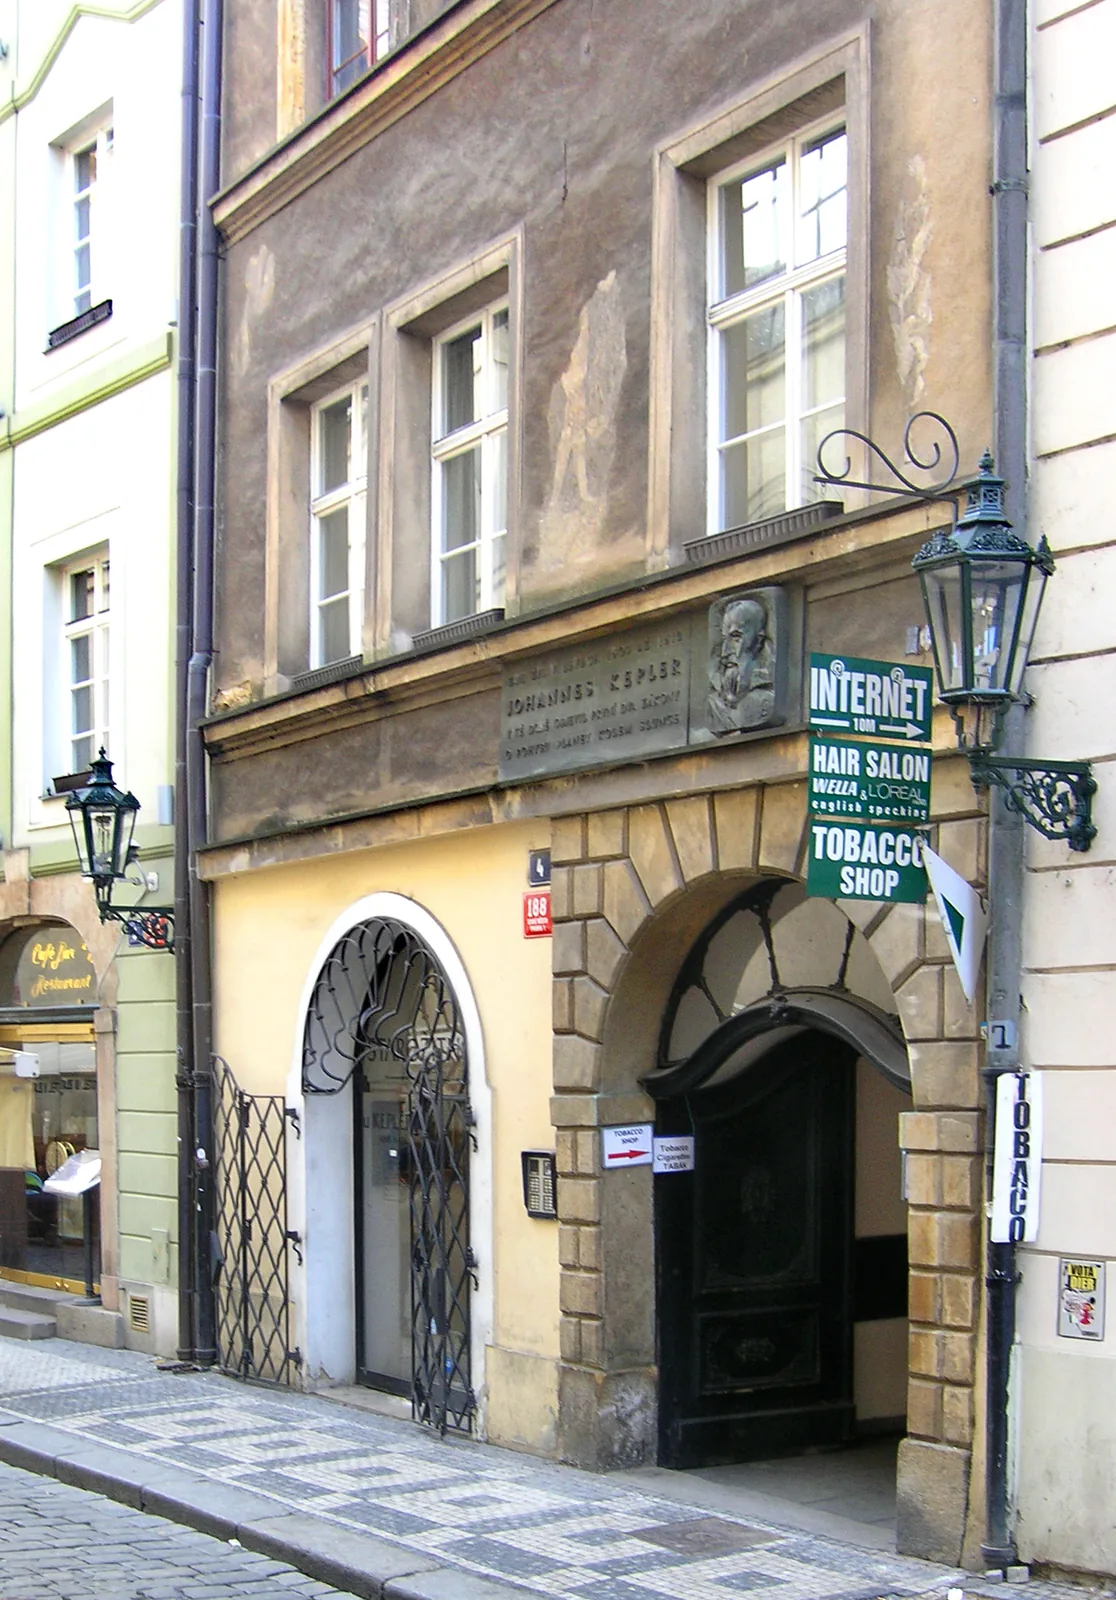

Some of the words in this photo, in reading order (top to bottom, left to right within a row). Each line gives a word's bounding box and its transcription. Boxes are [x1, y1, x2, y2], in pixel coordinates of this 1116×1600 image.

[610, 658, 681, 692] KEPLER
[810, 667, 928, 721] INTERNET
[812, 744, 861, 777] HAIR
[864, 750, 929, 783] SALON
[811, 799, 862, 813] english
[812, 777, 859, 797] WELLA
[859, 789, 868, 801] &
[812, 825, 928, 869] TOBACCO
[839, 865, 900, 898] SHOP
[527, 896, 548, 918] 188
[1008, 1073, 1031, 1244] TOBACO
